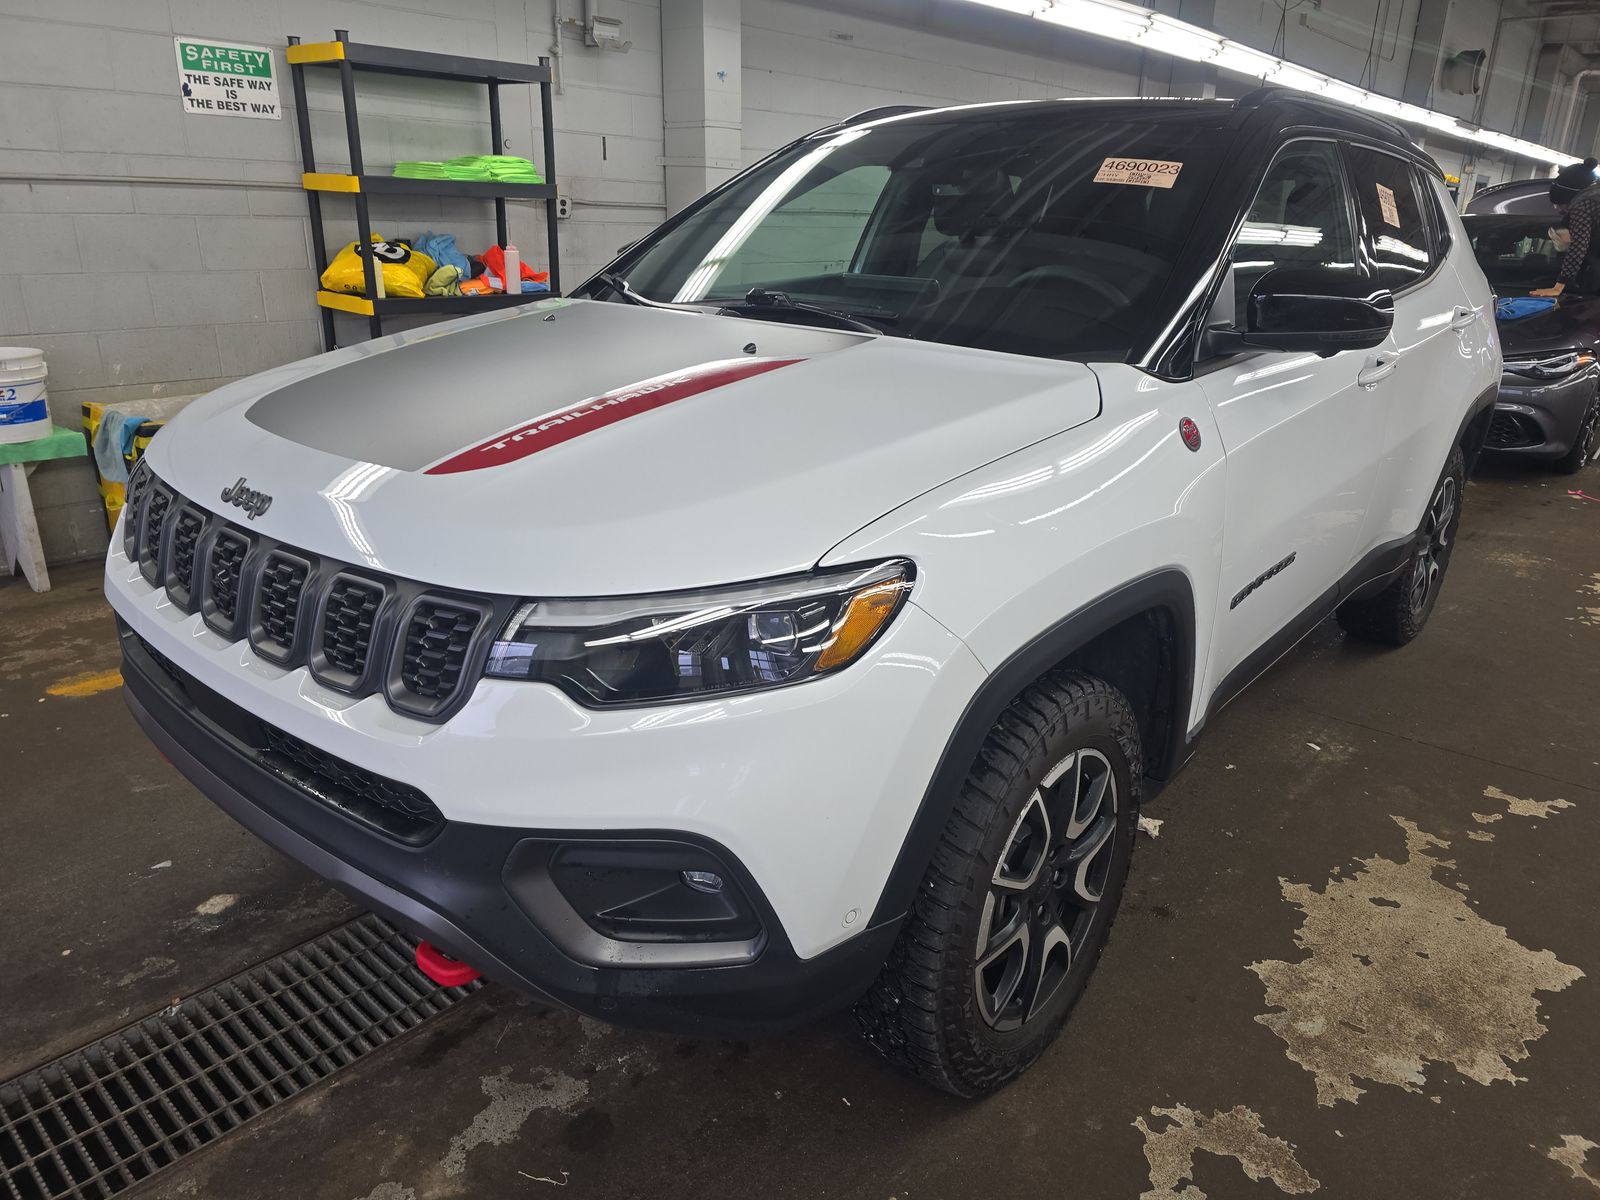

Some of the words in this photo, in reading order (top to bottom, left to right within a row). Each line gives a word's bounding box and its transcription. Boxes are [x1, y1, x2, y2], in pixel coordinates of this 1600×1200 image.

[185, 45, 265, 68] SAFETY
[202, 59, 256, 74] FIRST
[184, 73, 210, 86] THE
[213, 76, 245, 89] SAFE
[247, 79, 272, 91] WAY
[225, 89, 238, 100] IS
[187, 98, 213, 110] THE
[216, 100, 247, 112] BEST
[250, 103, 276, 114] WAY
[1104, 160, 1181, 175] 4690023
[479, 375, 692, 453] TRAILHAWK
[220, 477, 273, 521] Jeep
